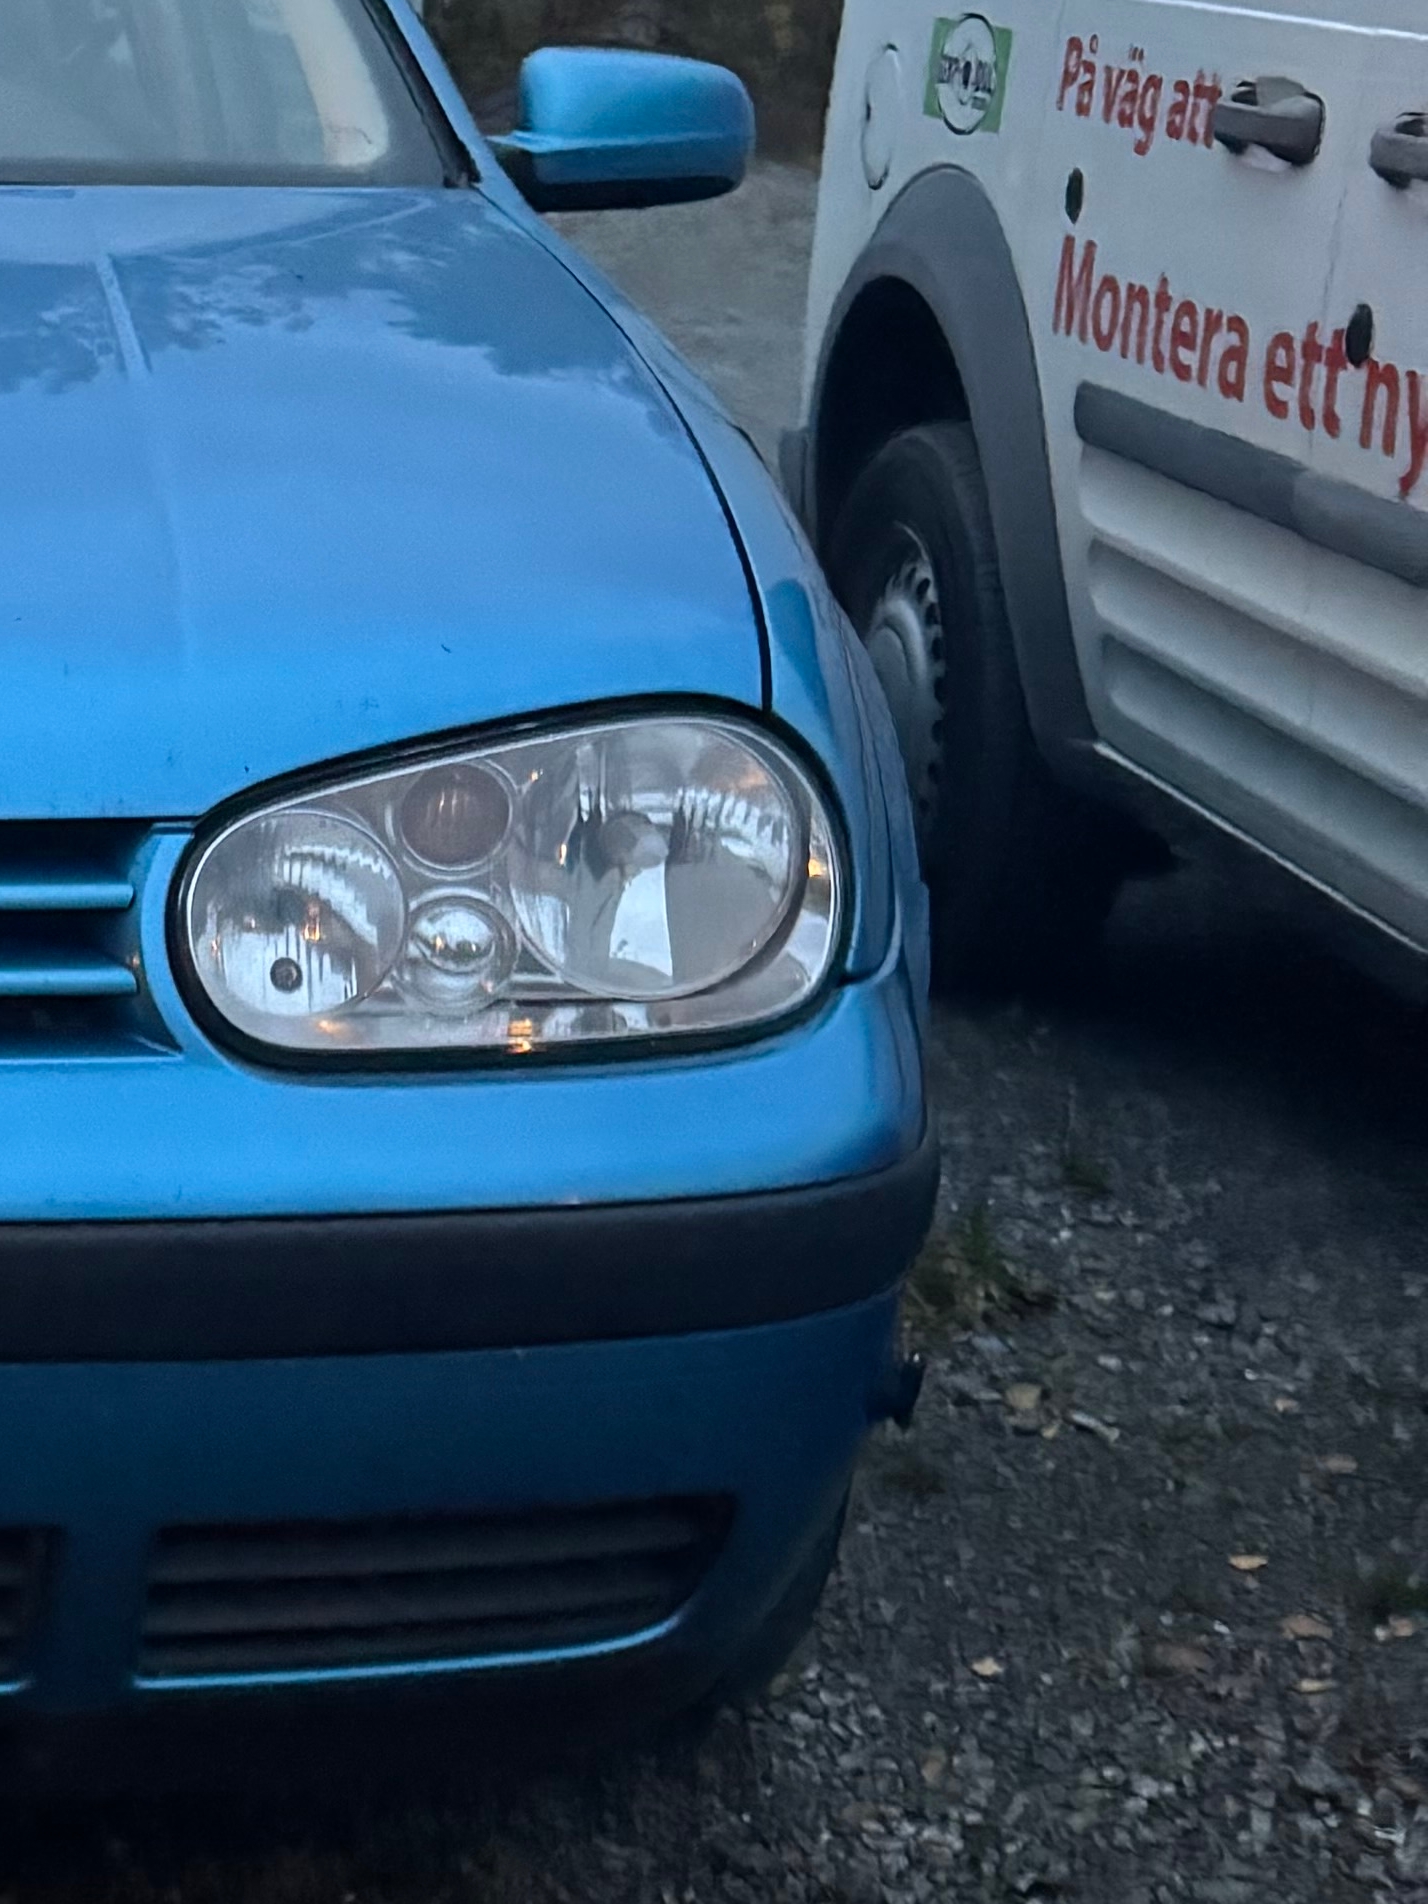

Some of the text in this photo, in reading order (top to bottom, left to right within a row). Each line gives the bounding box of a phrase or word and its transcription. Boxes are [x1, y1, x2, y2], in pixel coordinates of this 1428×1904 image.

[1056, 34, 1099, 117] På
[1103, 44, 1163, 156] väg
[1166, 68, 1223, 150] att
[1051, 234, 1250, 402] Montera
[1264, 321, 1348, 440] ett
